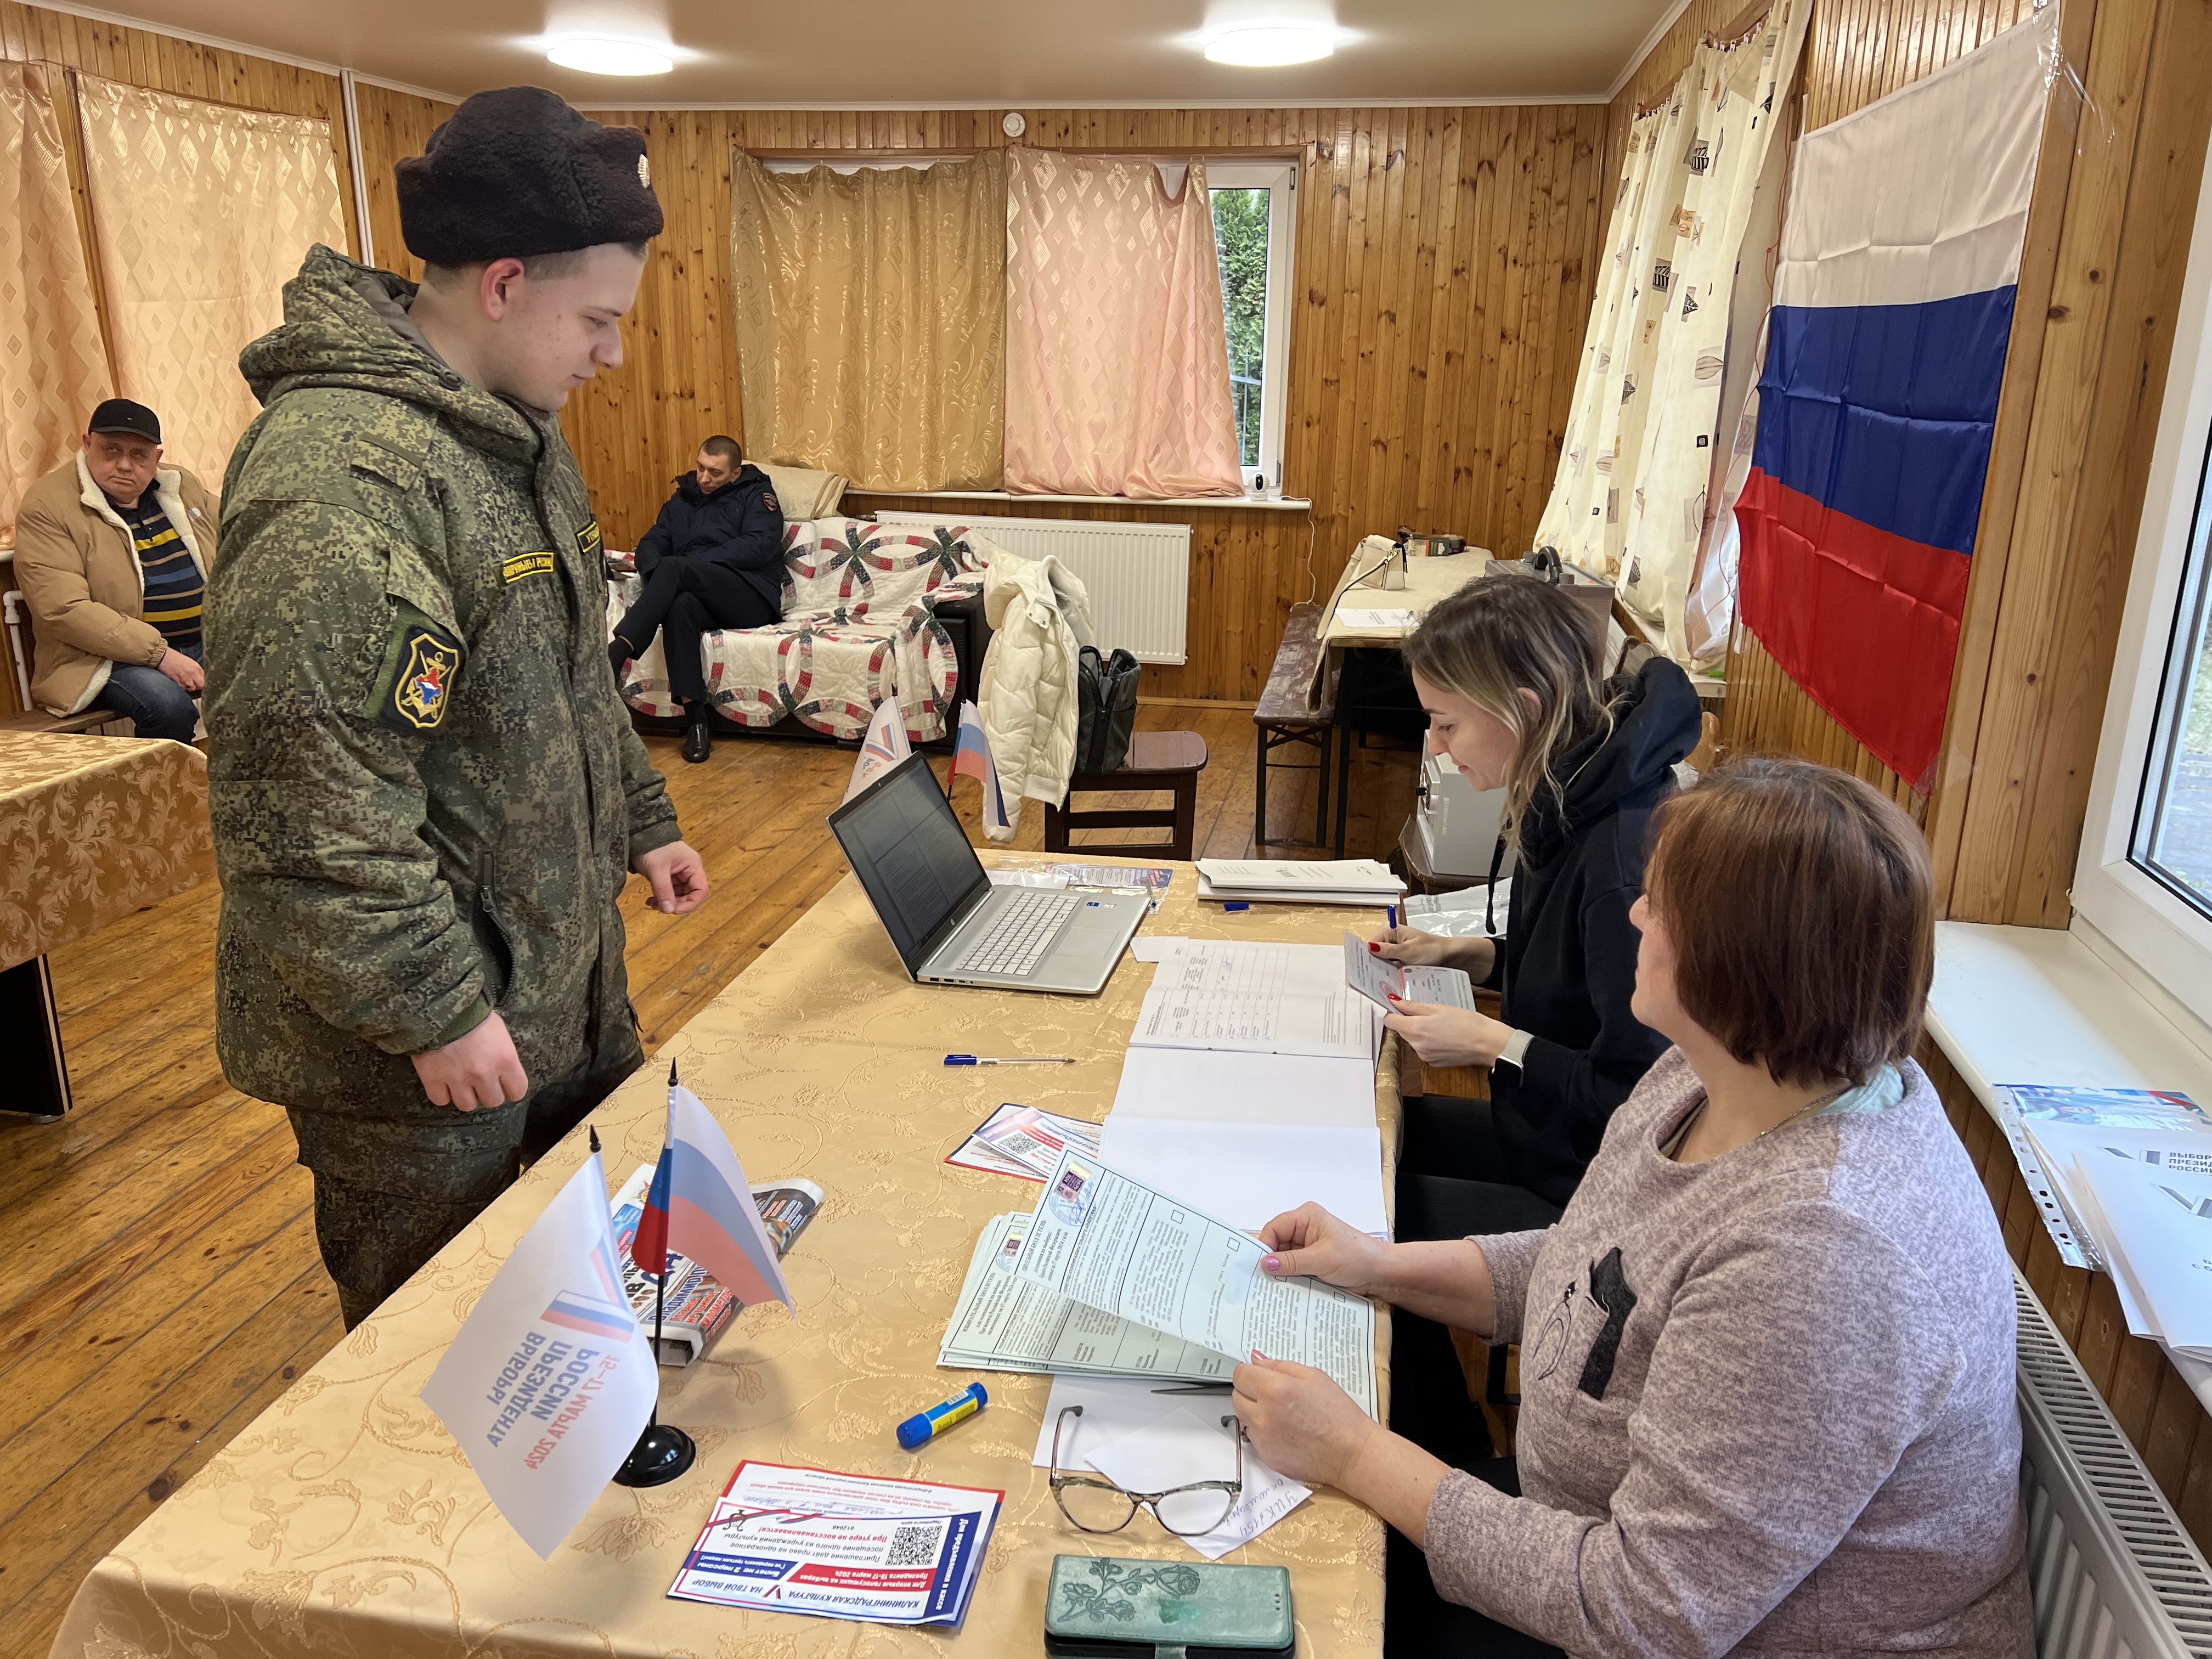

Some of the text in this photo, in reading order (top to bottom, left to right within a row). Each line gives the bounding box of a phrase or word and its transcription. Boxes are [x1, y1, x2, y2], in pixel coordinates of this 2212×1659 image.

[1056, 1240, 1065, 1251] 2024
[958, 1518, 968, 1533] Для
[724, 1531, 758, 1542] культуры
[758, 1525, 836, 1540] восстанавливается!
[758, 1535, 804, 1547] учреждений
[848, 1533, 871, 1543] утере
[872, 1533, 887, 1543] При
[730, 1541, 777, 1553] однократное
[815, 1542, 840, 1550] одного
[788, 1548, 810, 1556] право
[811, 1550, 830, 1559] даёт
[943, 1531, 963, 1583] предъявления
[831, 1553, 880, 1562] Приглашение
[696, 1561, 733, 1571] персоны
[754, 1567, 780, 1577] Билет
[851, 1570, 871, 1578] марта
[872, 1572, 888, 1580] 15-17
[889, 1572, 928, 1582] Президента
[799, 1574, 829, 1582] выборах
[839, 1577, 881, 1586] голосующих
[882, 1579, 911, 1588] впервые
[911, 1579, 926, 1589] Для
[691, 1578, 919, 1608] КАЛИНИНГРАДСКАЯ КУЛЬТУРА НА ТВОЙ ВЫБОР
[935, 1588, 947, 1611] кассе
